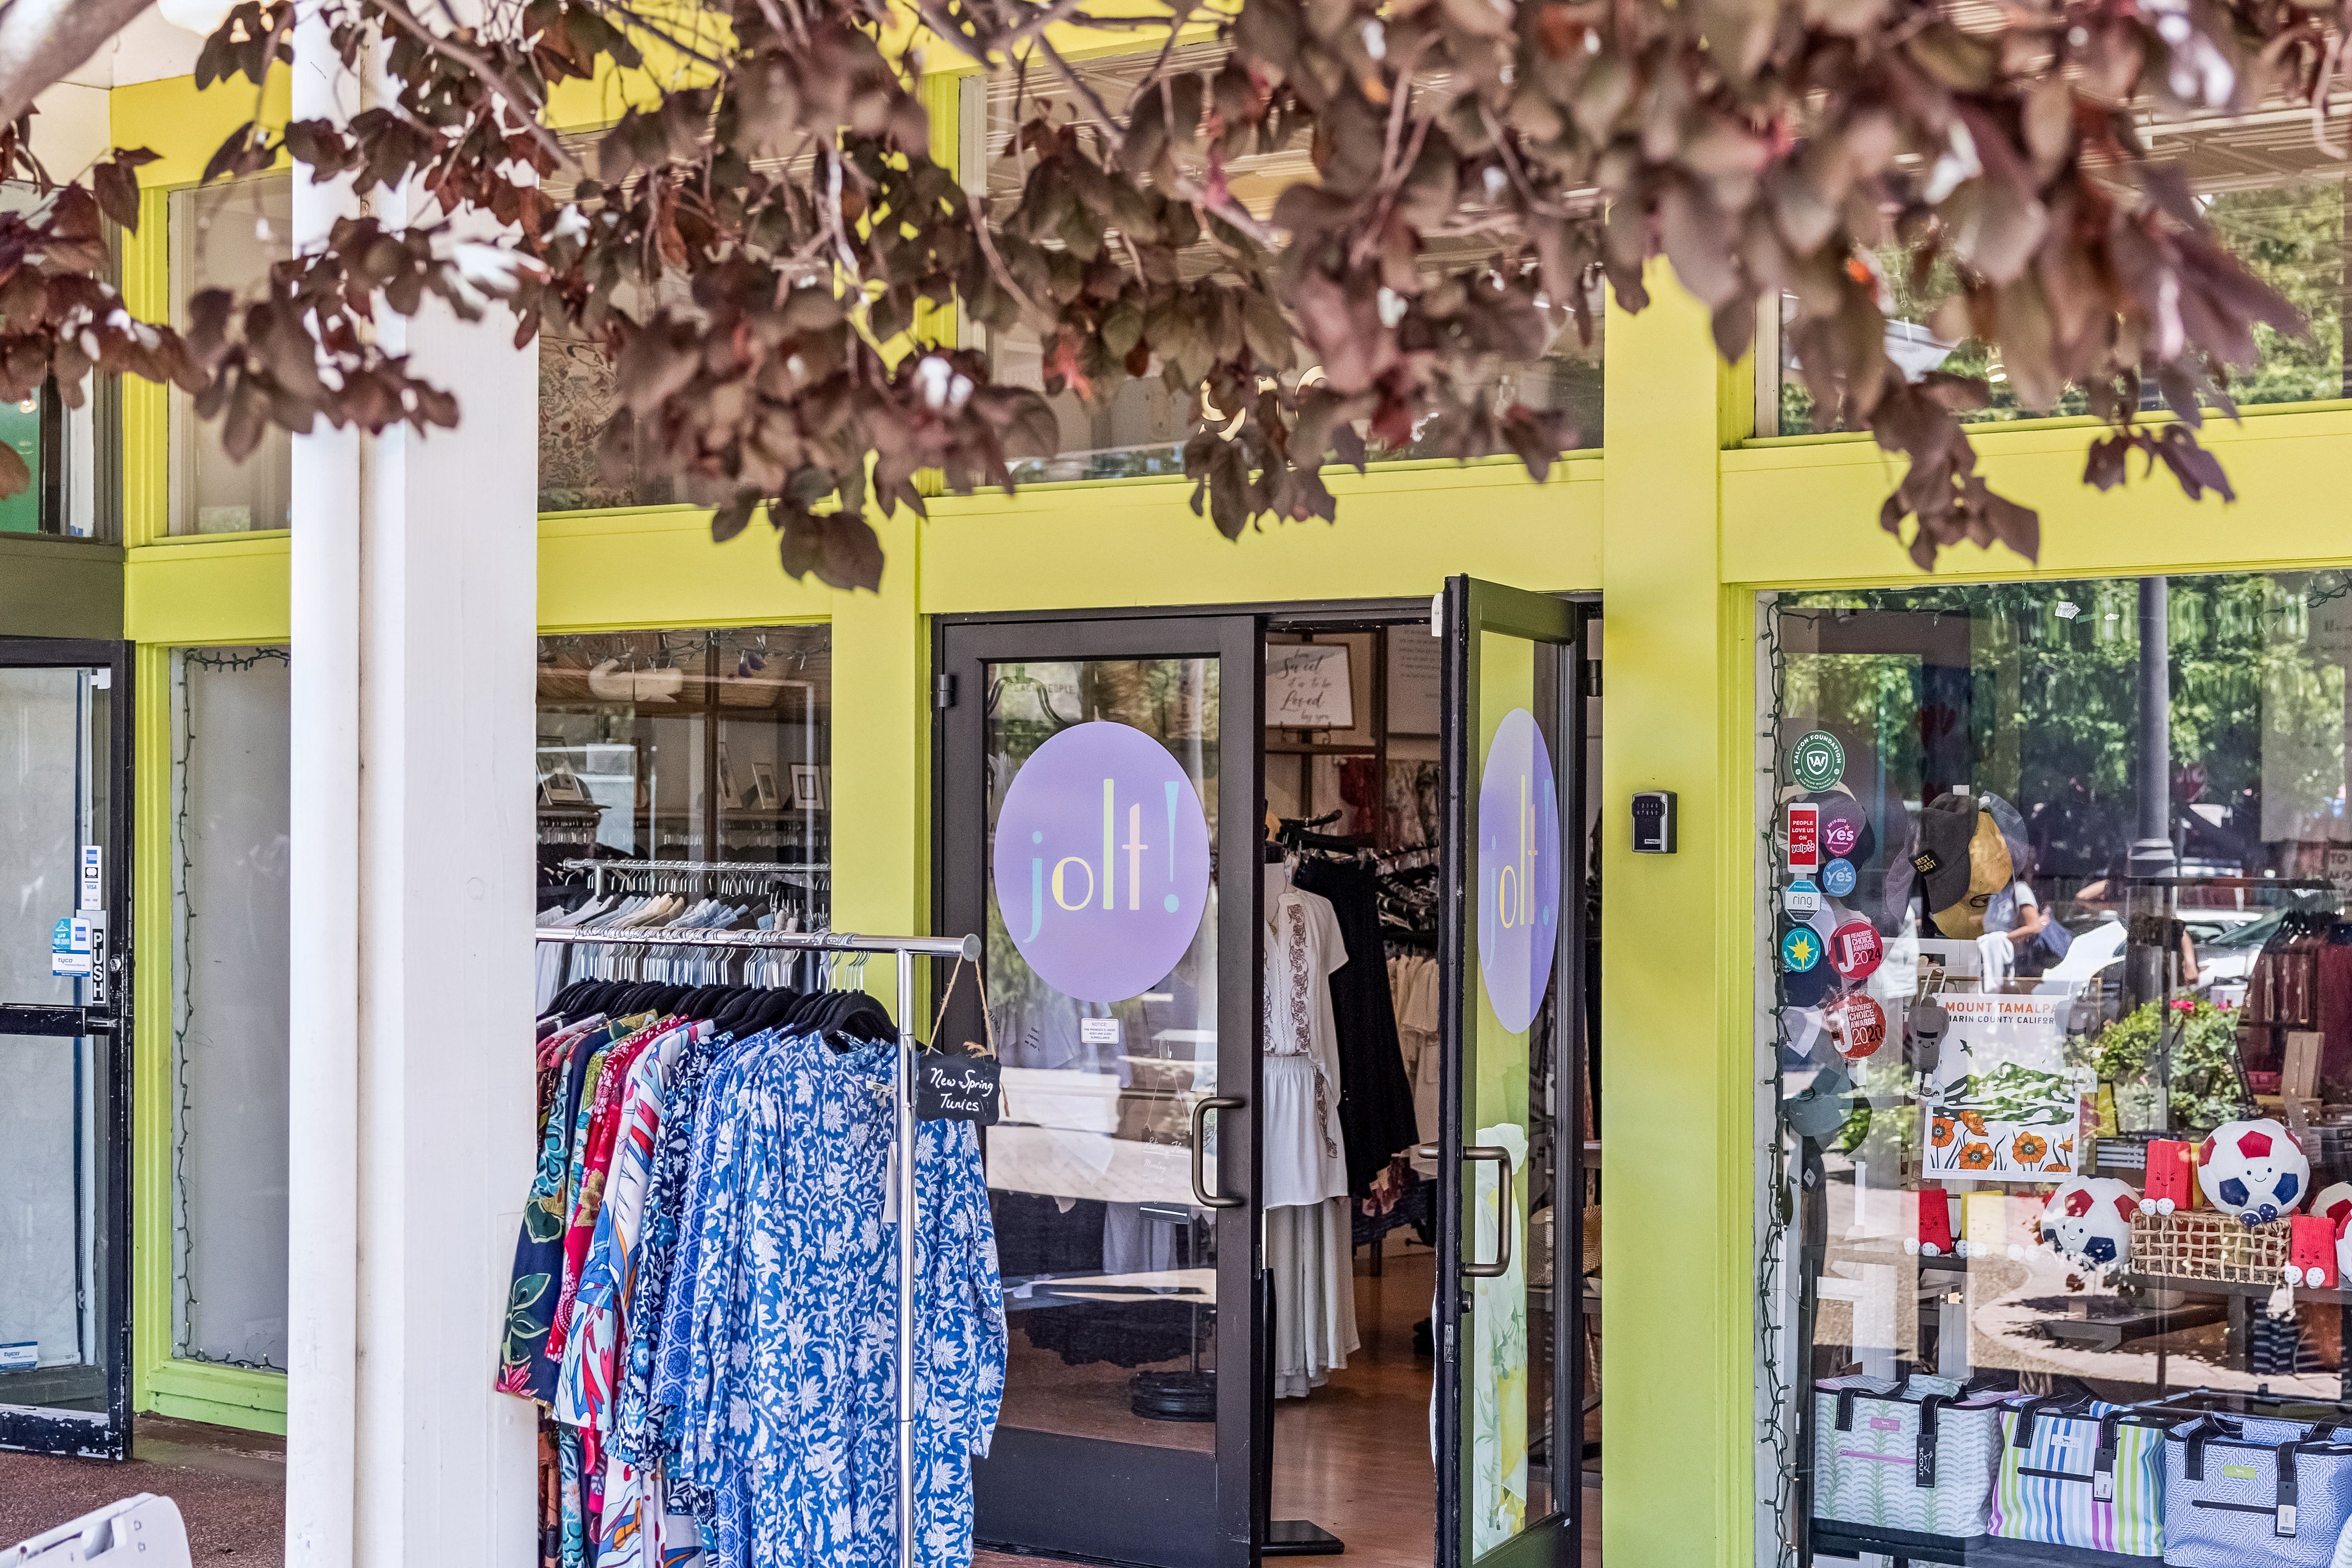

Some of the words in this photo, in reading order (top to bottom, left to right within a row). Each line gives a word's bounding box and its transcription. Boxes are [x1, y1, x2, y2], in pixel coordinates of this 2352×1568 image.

[1794, 737, 1809, 764] FALCON
[1810, 734, 1841, 763] FOUNDATION
[1819, 778, 1836, 789] SUPPORTER
[1791, 843, 1807, 854] yelp
[1022, 778, 1180, 943] jolt!
[1915, 855, 1930, 866] WEST
[1918, 860, 1936, 872] COAST
[1486, 775, 1550, 971] jolt!
[1793, 894, 1812, 908] ring
[1852, 935, 1873, 946] CHOICE
[1853, 941, 1875, 952] AWARDS
[1854, 948, 1882, 965] 2024
[94, 932, 103, 998] PUSH
[1945, 1001, 1992, 1012] MOUNT
[1849, 1009, 1875, 1021] CHOICE
[1851, 1017, 1876, 1029] AWARDS
[1852, 1024, 1883, 1045] 2020
[930, 1067, 956, 1089] New
[958, 1069, 994, 1097] Spring
[940, 1093, 979, 1112] Tunics
[1144, 1158, 1166, 1176] Monday
